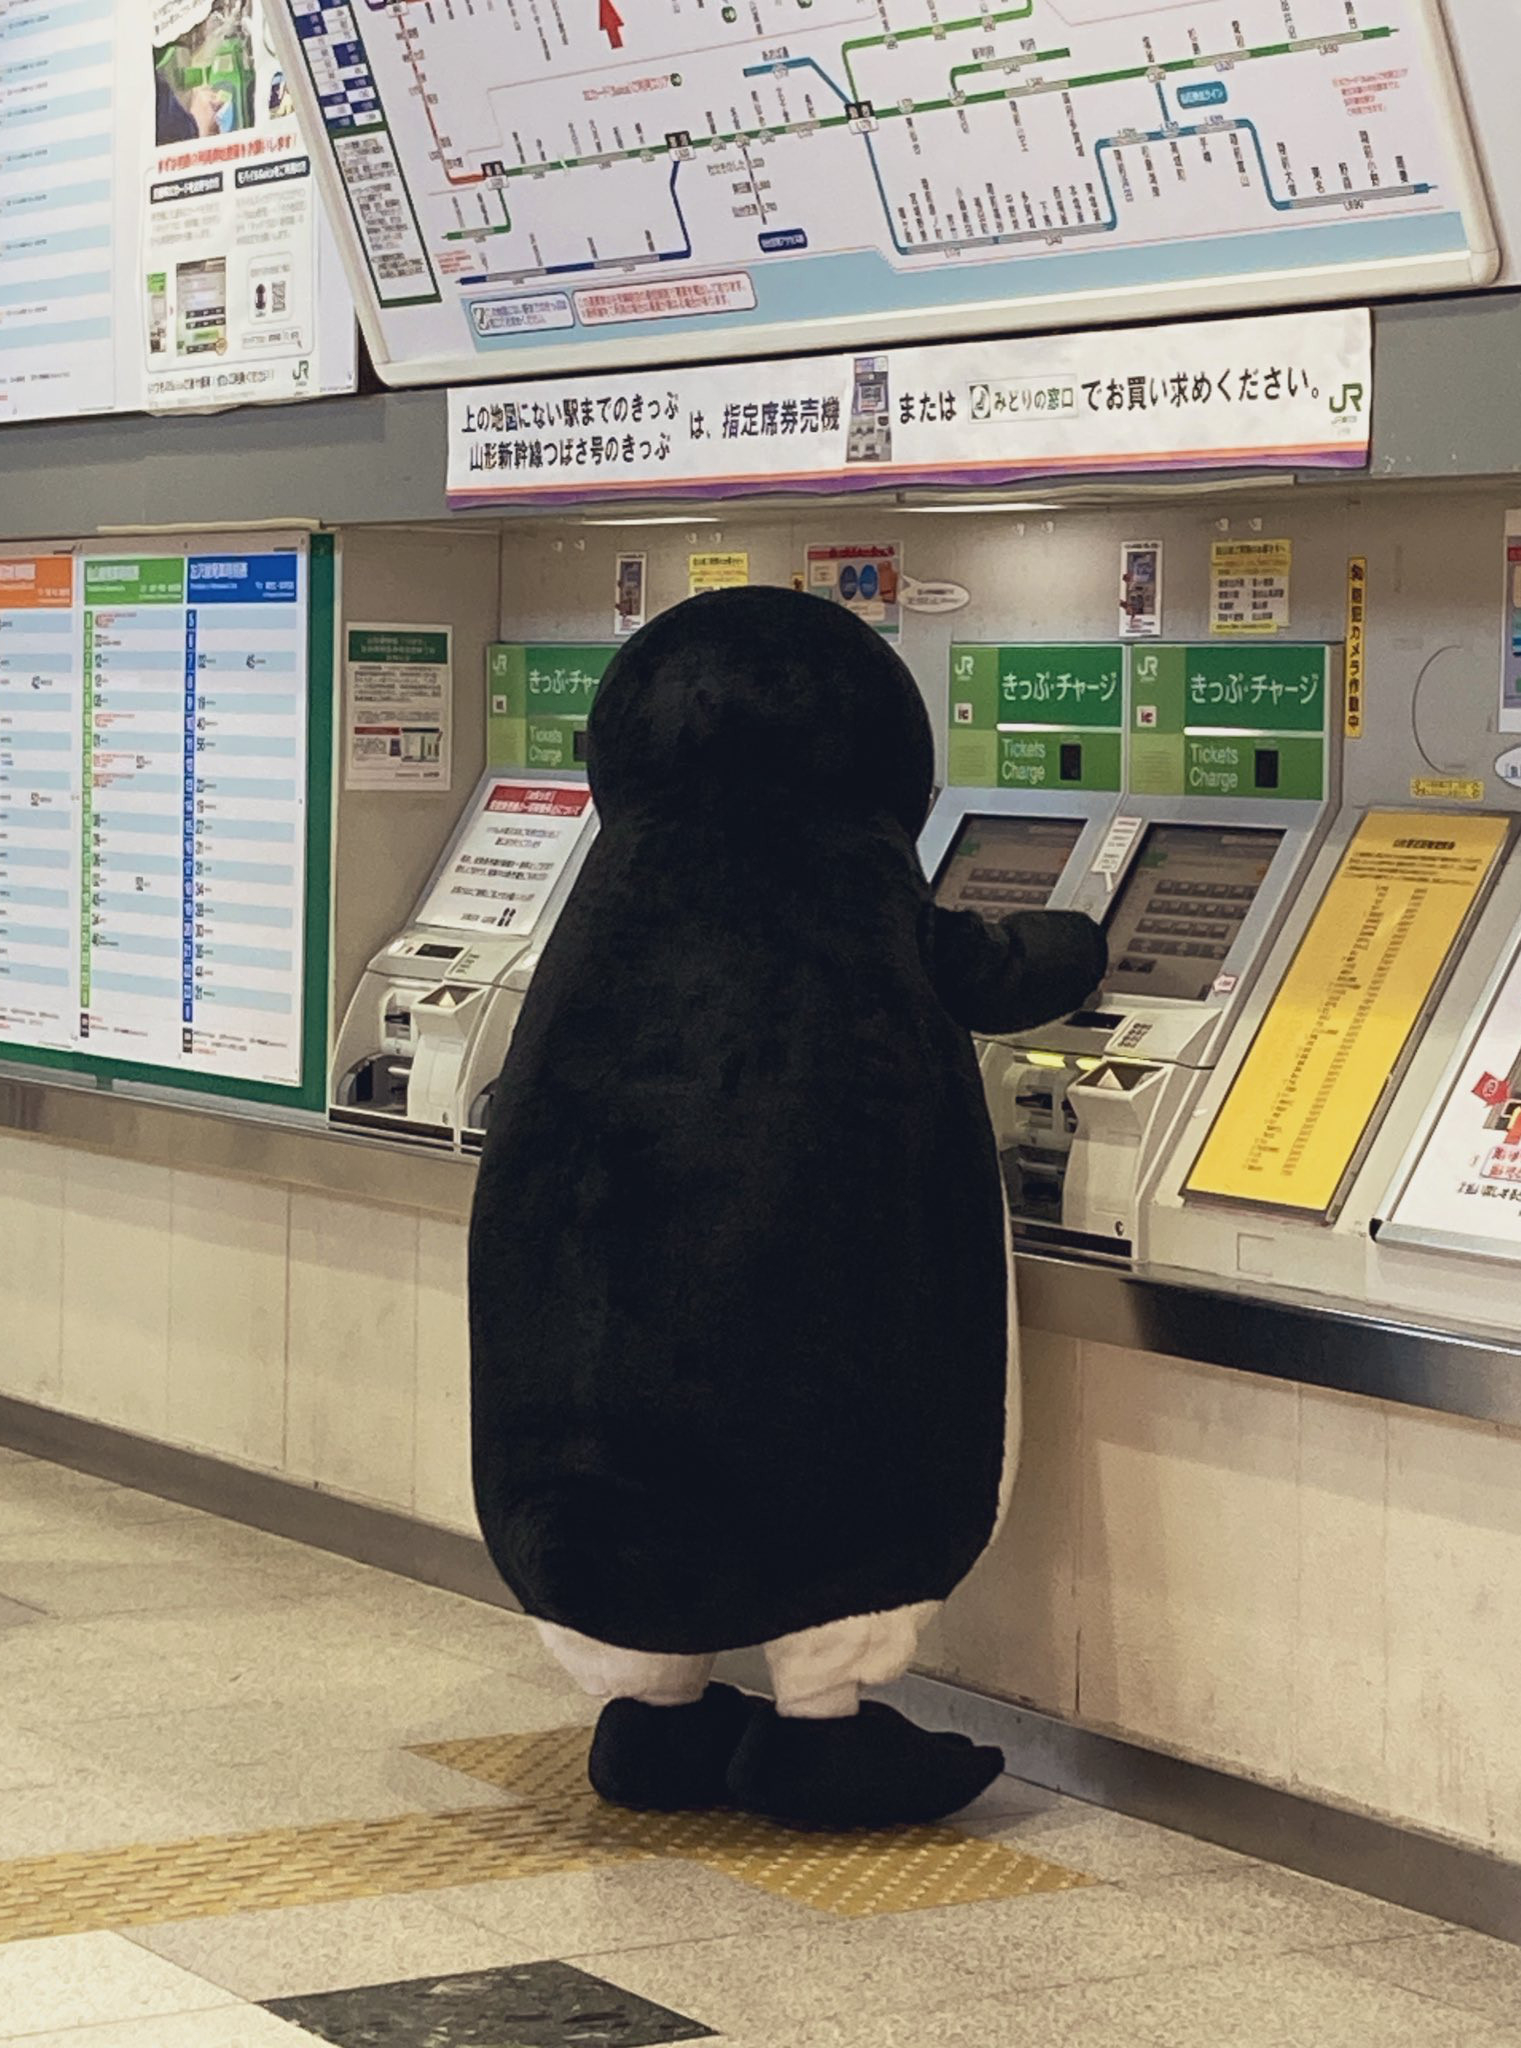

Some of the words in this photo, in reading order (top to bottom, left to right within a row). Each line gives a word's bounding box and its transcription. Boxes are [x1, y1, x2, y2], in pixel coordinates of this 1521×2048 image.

[292, 360, 309, 380] JR
[993, 386, 1075, 413] みどりの窓口
[1081, 366, 1320, 411] でお買い求めください。
[1329, 382, 1363, 414] JR
[461, 392, 679, 433] 上の地図にない駅までのきっぷ
[689, 396, 841, 440] は、指定席券売機
[899, 390, 957, 424] または
[469, 434, 671, 472] 山形新幹線つばさ号のきっぷ
[955, 656, 974, 676] JR
[1137, 655, 1158, 677] JR
[1002, 672, 1117, 702] きっぷ・チャージ
[1191, 673, 1319, 705] きっぷ・チャージ
[529, 726, 563, 744] Tickets
[529, 746, 563, 764] Charge
[1002, 738, 1046, 758] Tickets
[1190, 743, 1239, 765] Tickets
[1002, 761, 1045, 782] Charge
[1190, 767, 1238, 789] Charge
